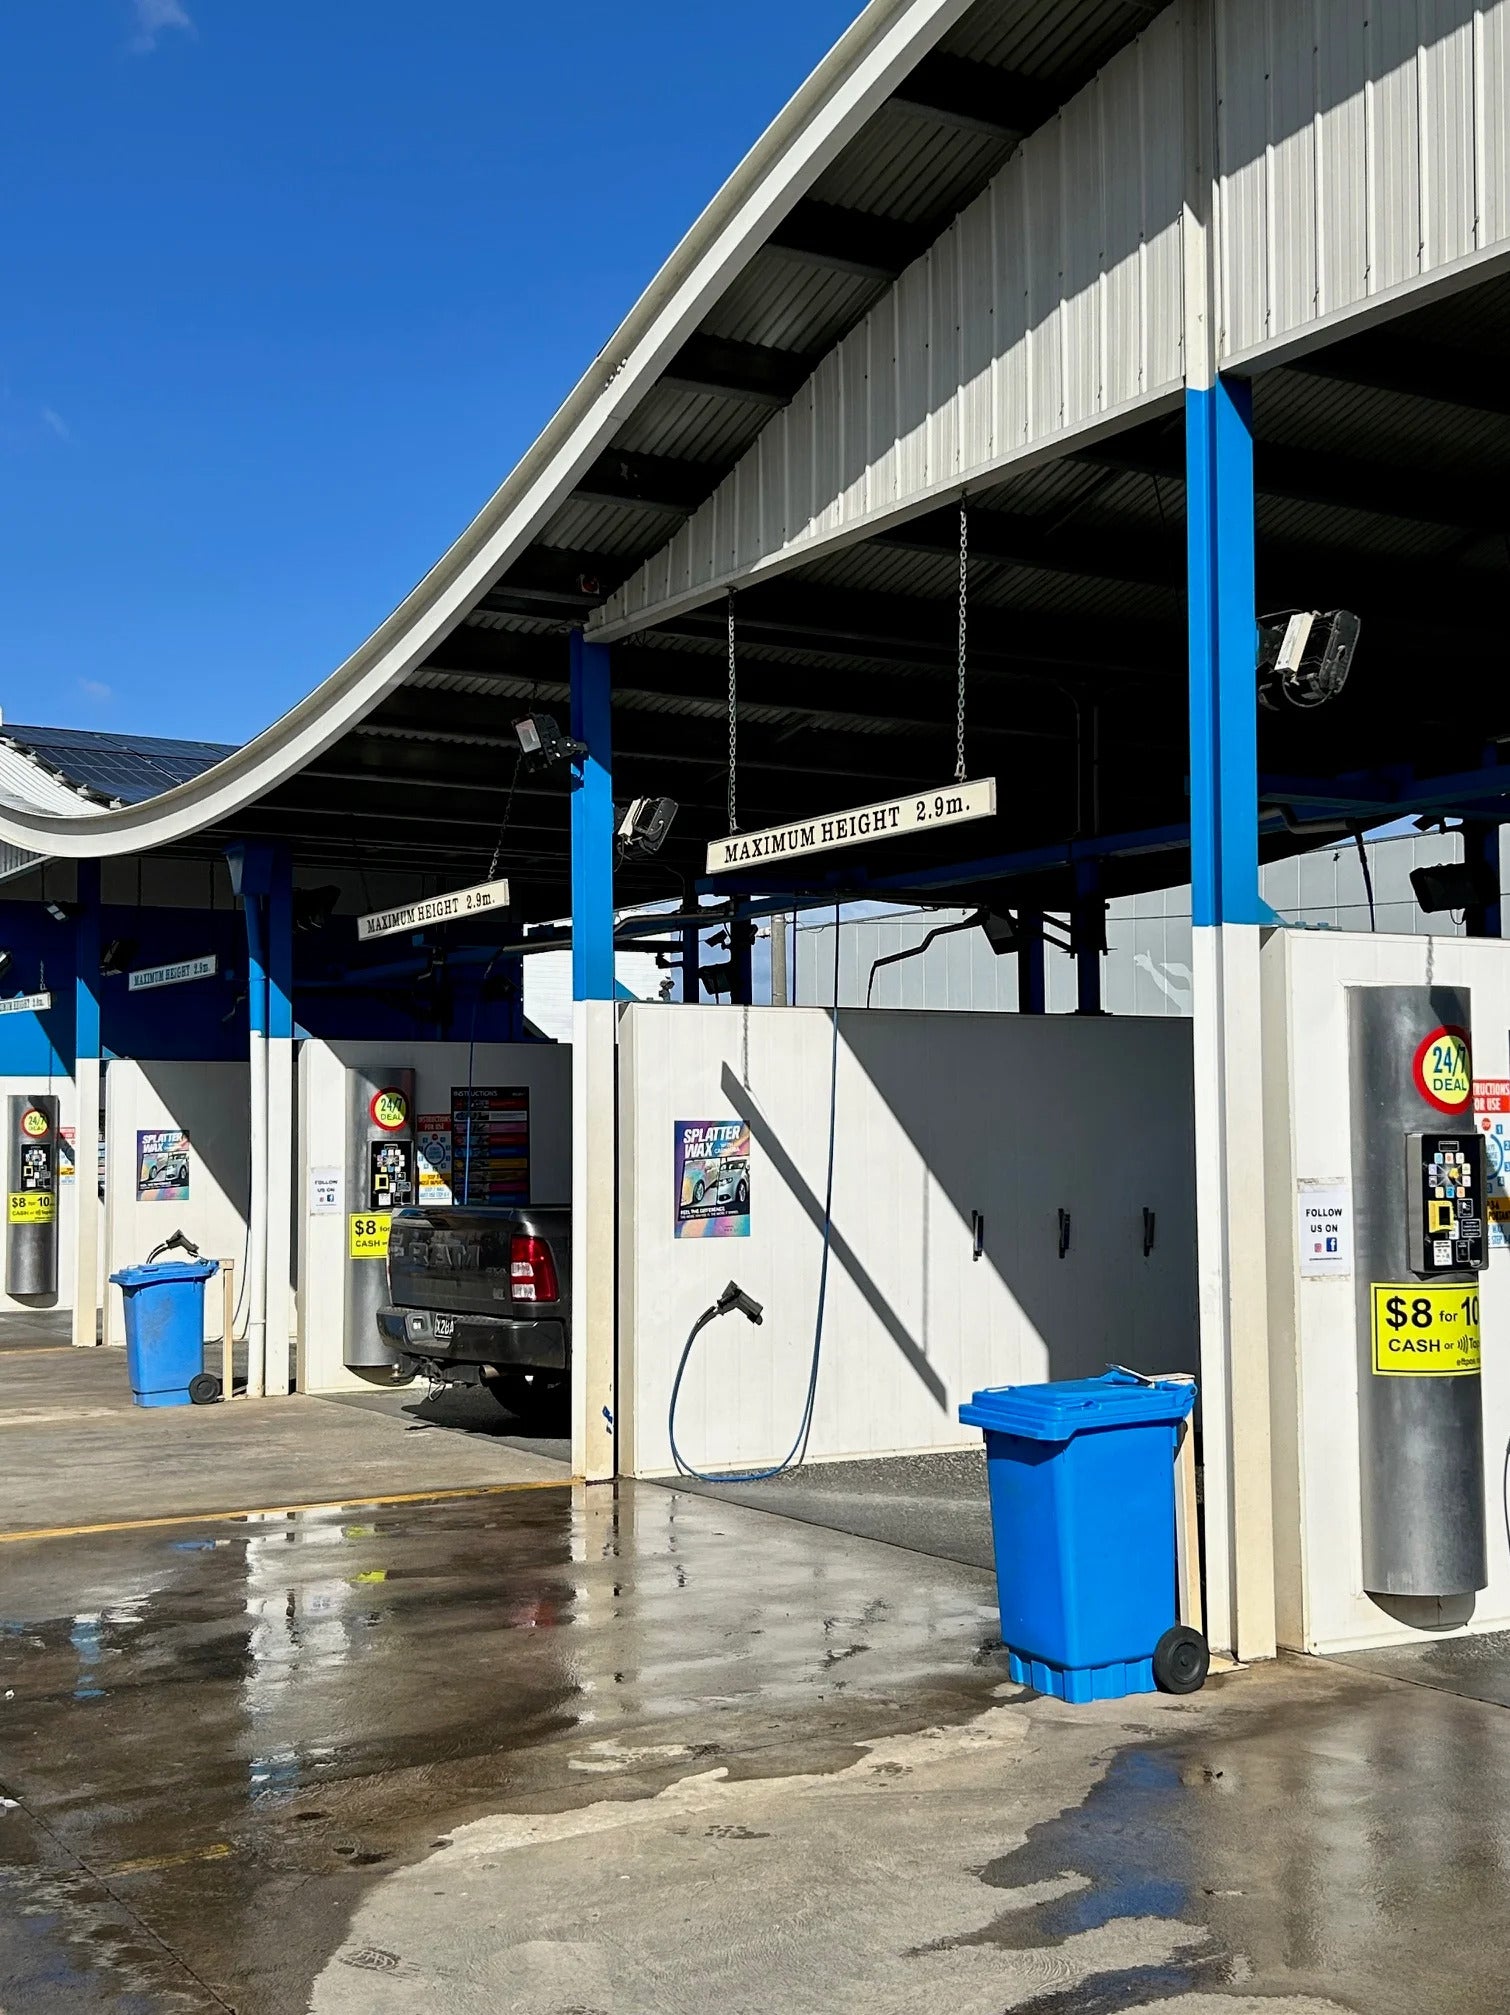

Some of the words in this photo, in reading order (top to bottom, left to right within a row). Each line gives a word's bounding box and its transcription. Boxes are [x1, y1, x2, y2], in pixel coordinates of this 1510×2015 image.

[724, 826, 815, 863] MAXIMUM
[821, 806, 900, 843] HEIGHT
[916, 796, 970, 822] 2.9m.
[367, 909, 415, 933] MAXIMUM
[418, 898, 459, 921] HEIGHT
[133, 970, 164, 986] MAXIMUM
[165, 964, 190, 980] HEIGHT
[1433, 1044, 1466, 1077] 24/7
[1433, 1079, 1467, 1091] DEAL
[381, 1097, 402, 1113] 24/7
[1474, 1097, 1486, 1110] OR
[683, 1126, 741, 1144] SPLATTER
[685, 1142, 713, 1158] WAX
[1306, 1208, 1342, 1217] FOLLOW
[355, 1219, 376, 1237] $8
[1310, 1224, 1322, 1232] US
[1325, 1224, 1338, 1233] ON
[409, 1242, 480, 1266] RAM
[1386, 1296, 1433, 1331] $8
[1439, 1310, 1458, 1322] for
[1388, 1338, 1441, 1353] CASH
[1444, 1342, 1454, 1350] or
